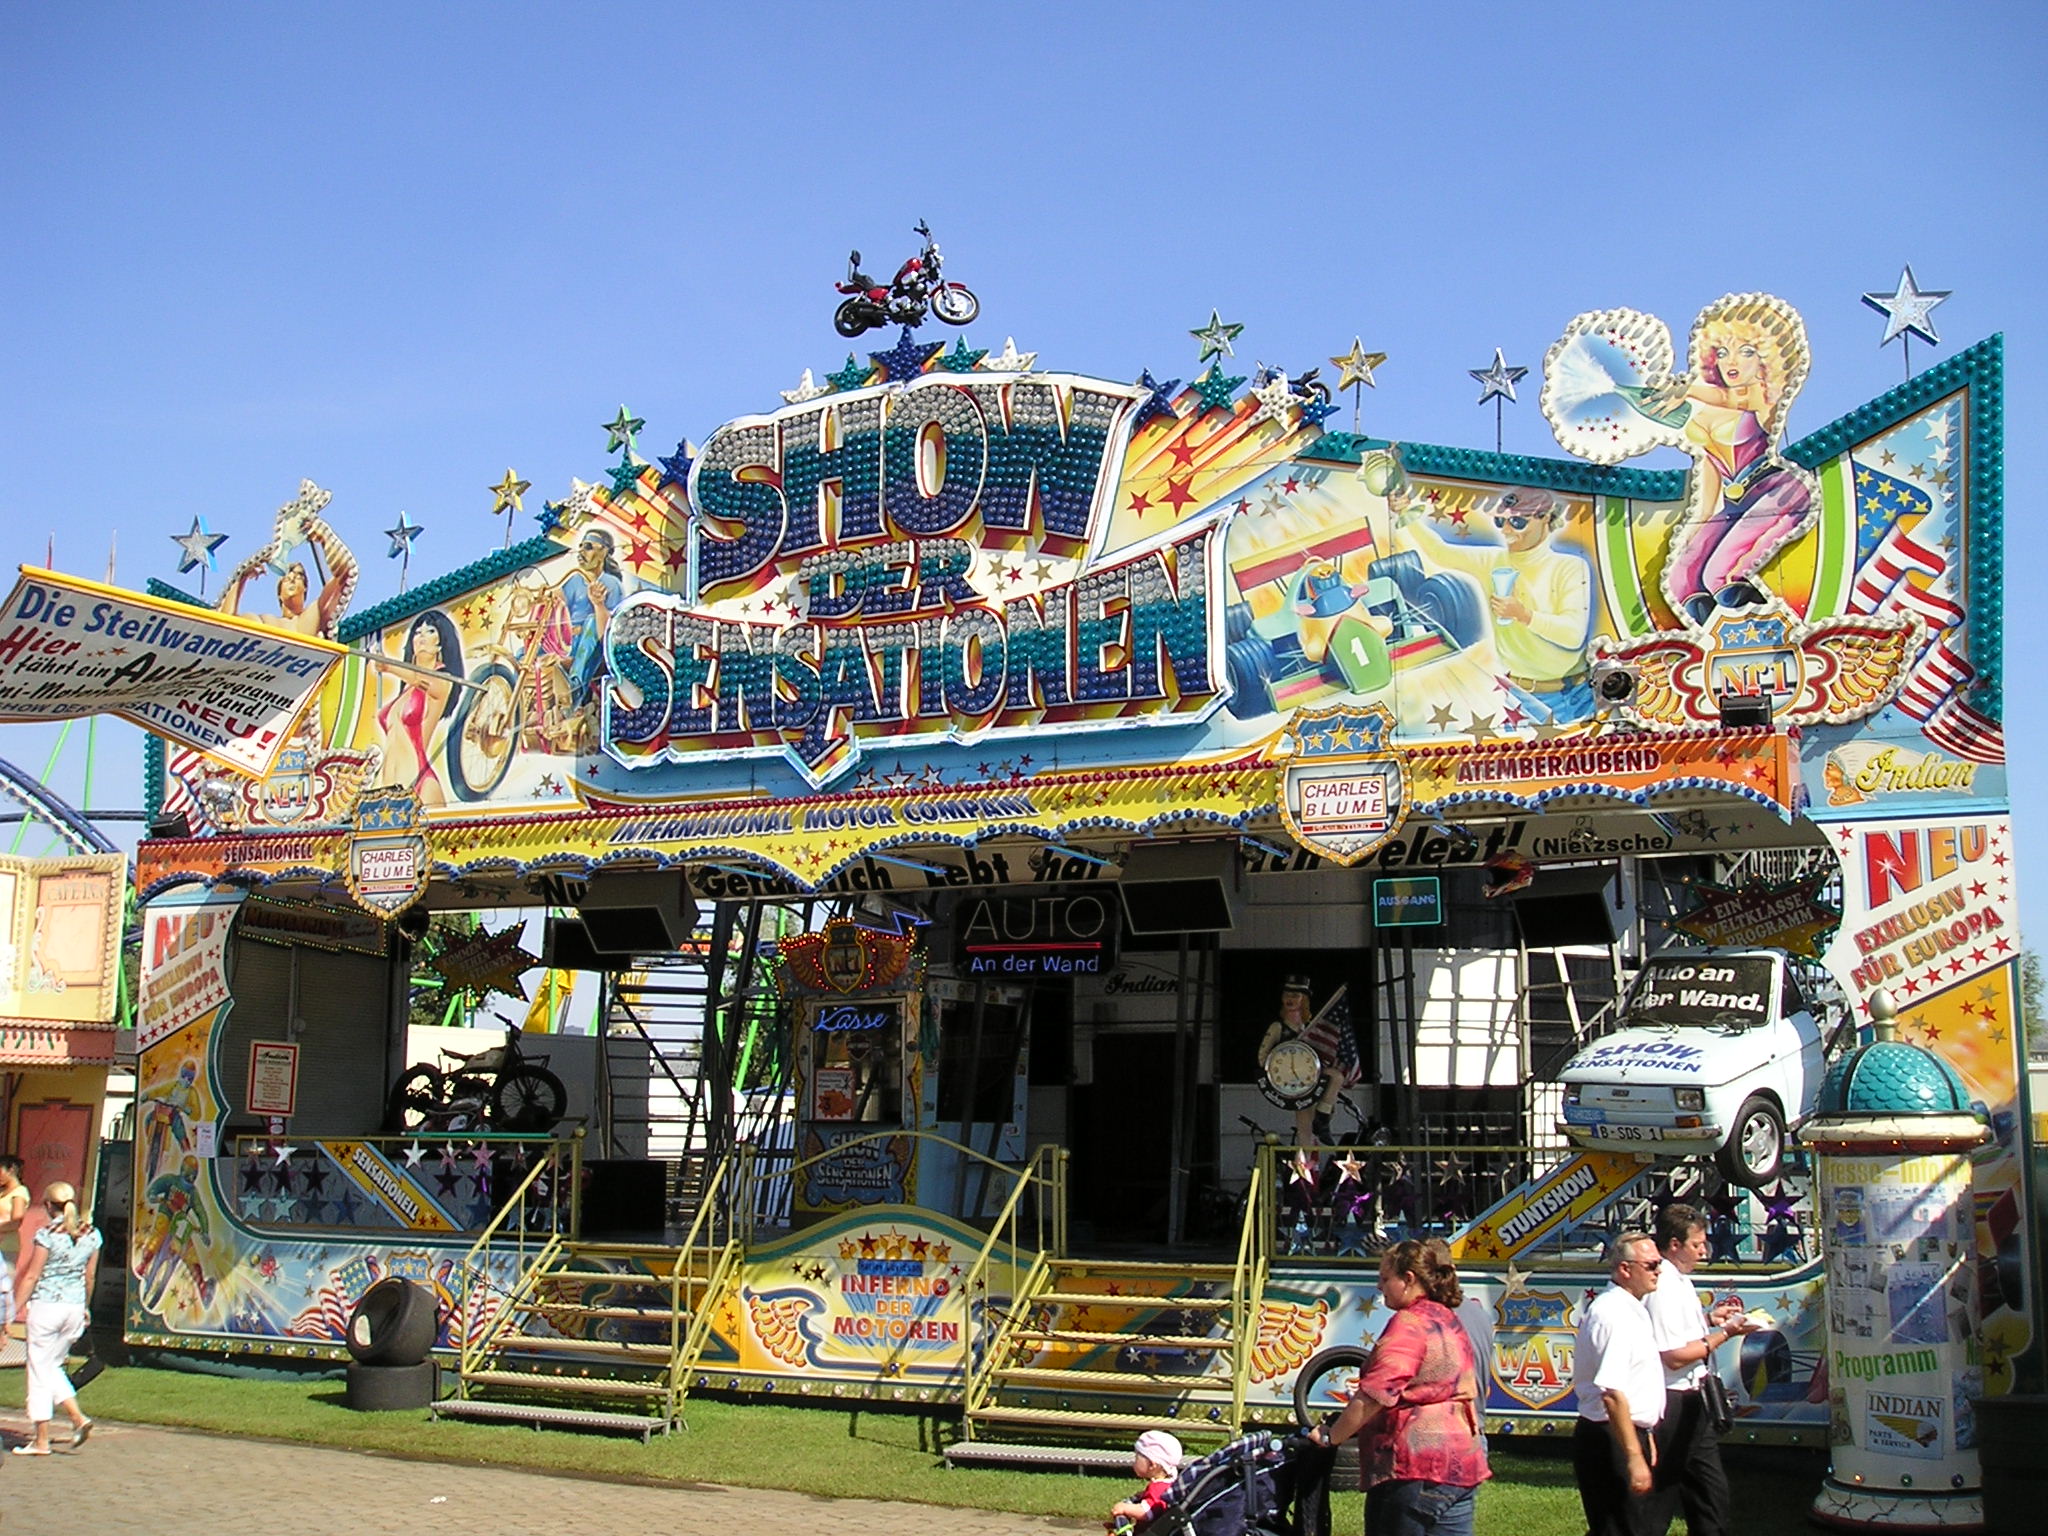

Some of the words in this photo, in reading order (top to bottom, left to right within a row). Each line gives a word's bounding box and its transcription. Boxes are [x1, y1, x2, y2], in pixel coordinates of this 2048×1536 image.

[697, 382, 1135, 596] SHOW
[801, 538, 979, 618] DER
[0, 626, 82, 666] Hier
[15, 585, 76, 627] Die
[84, 602, 325, 679] Steilwandfahrer
[608, 525, 1222, 768] SENSATIONEN
[1349, 636, 1367, 668] 1
[14, 654, 78, 675] fährt
[76, 662, 111, 679] ein
[103, 651, 214, 688] Auto
[246, 669, 277, 682] ein
[198, 688, 269, 720] Wand!
[207, 677, 296, 709] Programm
[1455, 748, 1660, 785] ATEMBERAUBEND
[1854, 748, 1978, 793] Indian
[1304, 780, 1381, 799] CHARLES
[607, 811, 796, 843] INTERNATIONAL
[804, 804, 897, 832] MOTOR
[901, 793, 1039, 826] COMPANY
[1305, 798, 1384, 817] BLUME
[223, 843, 314, 865] SENSATIONELL
[361, 849, 413, 864] CHARLES
[1863, 824, 1988, 911] NEU
[361, 864, 415, 879] BLUME
[1378, 894, 1437, 907] AUSGANG
[1703, 892, 1806, 940] WELTKLASSE
[1712, 898, 1744, 920] EIN
[963, 897, 1107, 942] AUTO
[1725, 906, 1815, 946] PROGRAMM
[1852, 884, 1968, 956] EXKLUSIV
[151, 912, 216, 972] NEU
[1850, 951, 1904, 993] FÜR
[1901, 904, 2005, 968] EUROPA
[969, 955, 998, 974] An
[1002, 954, 1039, 973] der
[1043, 953, 1100, 973] Wand
[1642, 963, 1696, 982] Auto
[1698, 967, 1736, 983] an
[1104, 970, 1181, 994] Indian
[1630, 991, 1675, 1010] der
[1679, 989, 1766, 1013] Wand.
[811, 1006, 889, 1032] Kasse
[1565, 1057, 1702, 1073] SENSATIONEN
[1592, 1042, 1704, 1060] SHOW
[829, 1130, 882, 1160] SHOW
[350, 1147, 421, 1223] SENSATIONELL
[816, 1161, 893, 1192] SENSATIONEN
[1496, 1163, 1597, 1248] STUNTSHOW
[839, 1274, 951, 1298] INFERNO
[875, 1299, 913, 1318] DER
[832, 1316, 960, 1343] MOTOREN
[1834, 1348, 1939, 1383] Programm
[1867, 1394, 1943, 1418] INDIAN
[1867, 1428, 1894, 1441] PARTS
